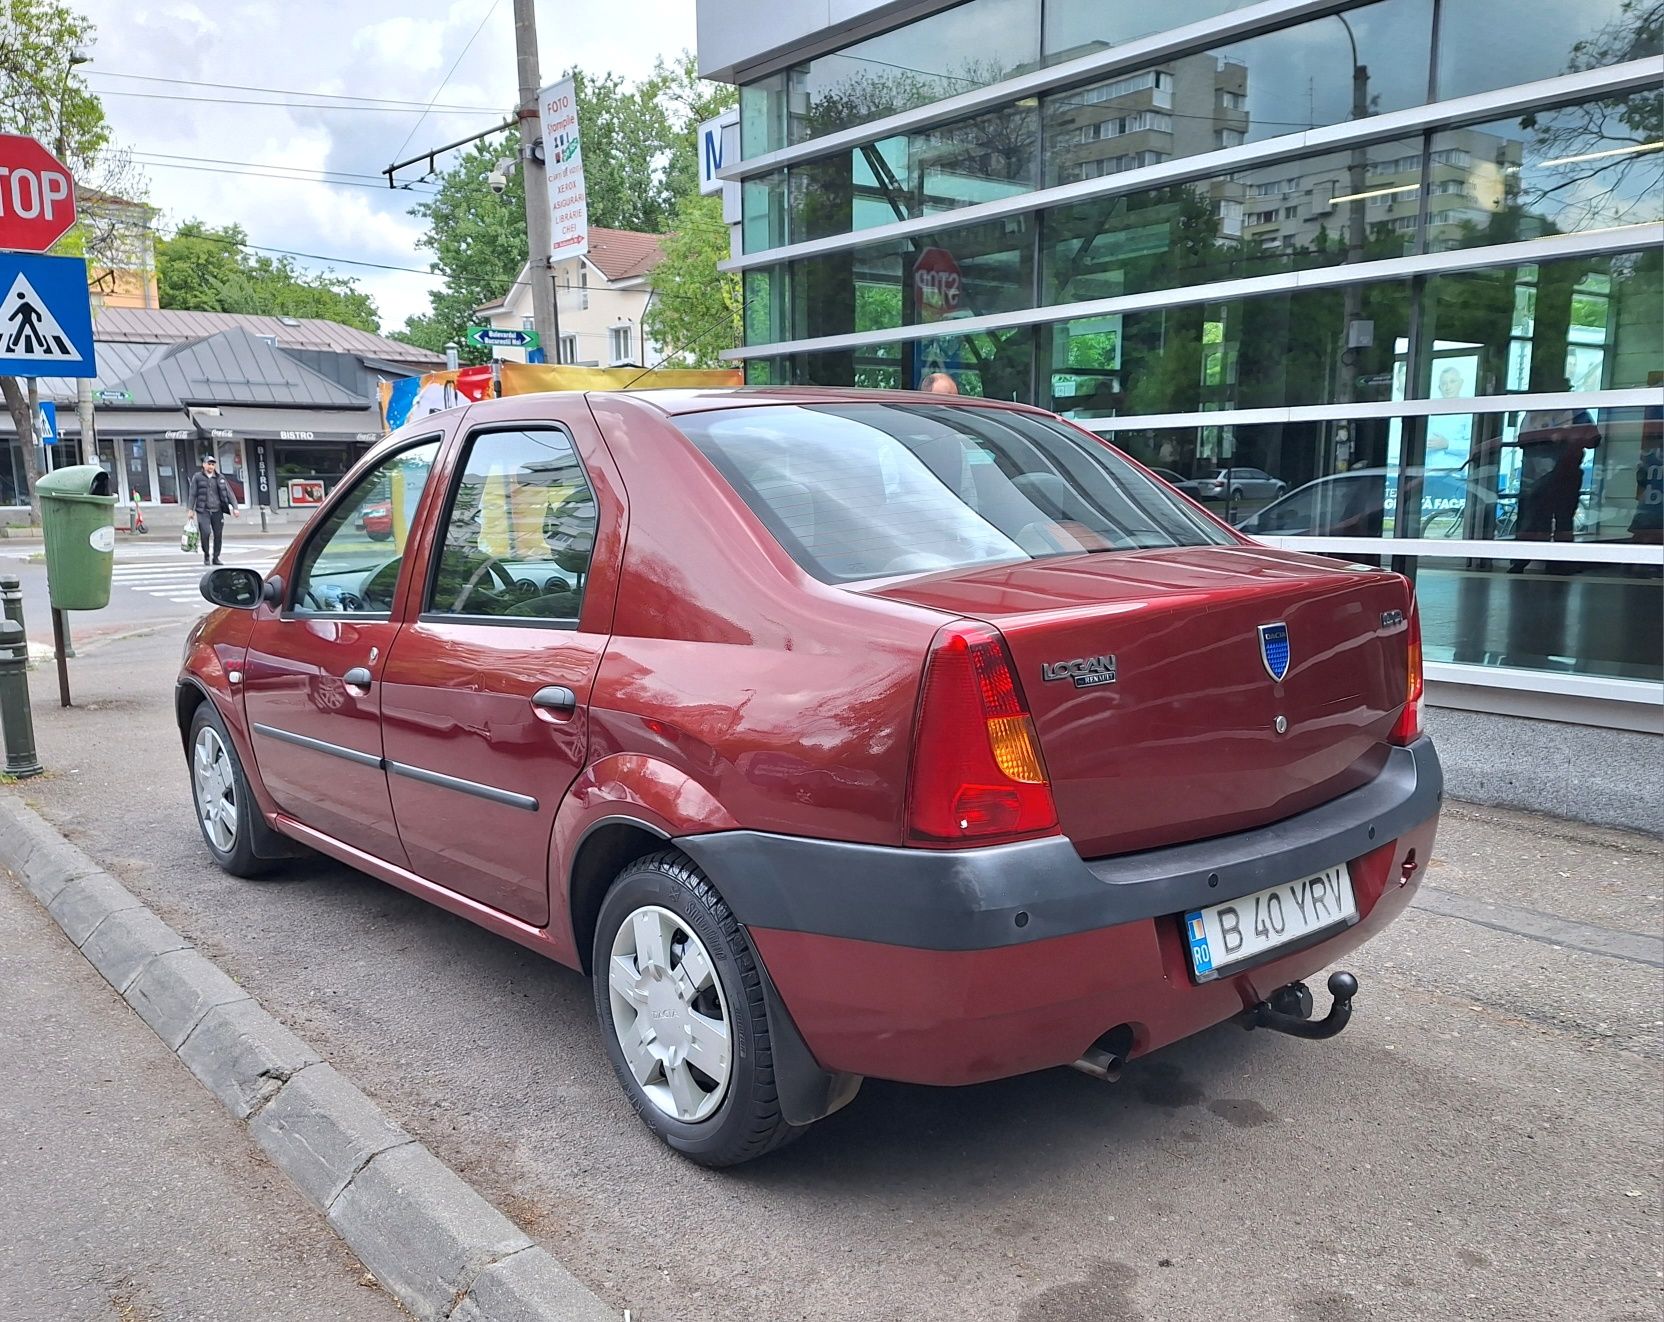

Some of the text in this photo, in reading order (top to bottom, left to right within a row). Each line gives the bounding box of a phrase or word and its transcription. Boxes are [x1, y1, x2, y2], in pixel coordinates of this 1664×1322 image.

[547, 96, 569, 115] FOTO
[557, 180, 577, 194] XEROX
[561, 223, 577, 235] CHEI
[280, 431, 314, 440] BISTRO
[257, 446, 268, 492] BISTRO
[1265, 631, 1286, 640] DACIA
[1042, 654, 1116, 682] LOGAN
[1084, 673, 1114, 685] RENAULT
[1216, 868, 1343, 955] B 40 YRV
[1193, 944, 1210, 965] RO
